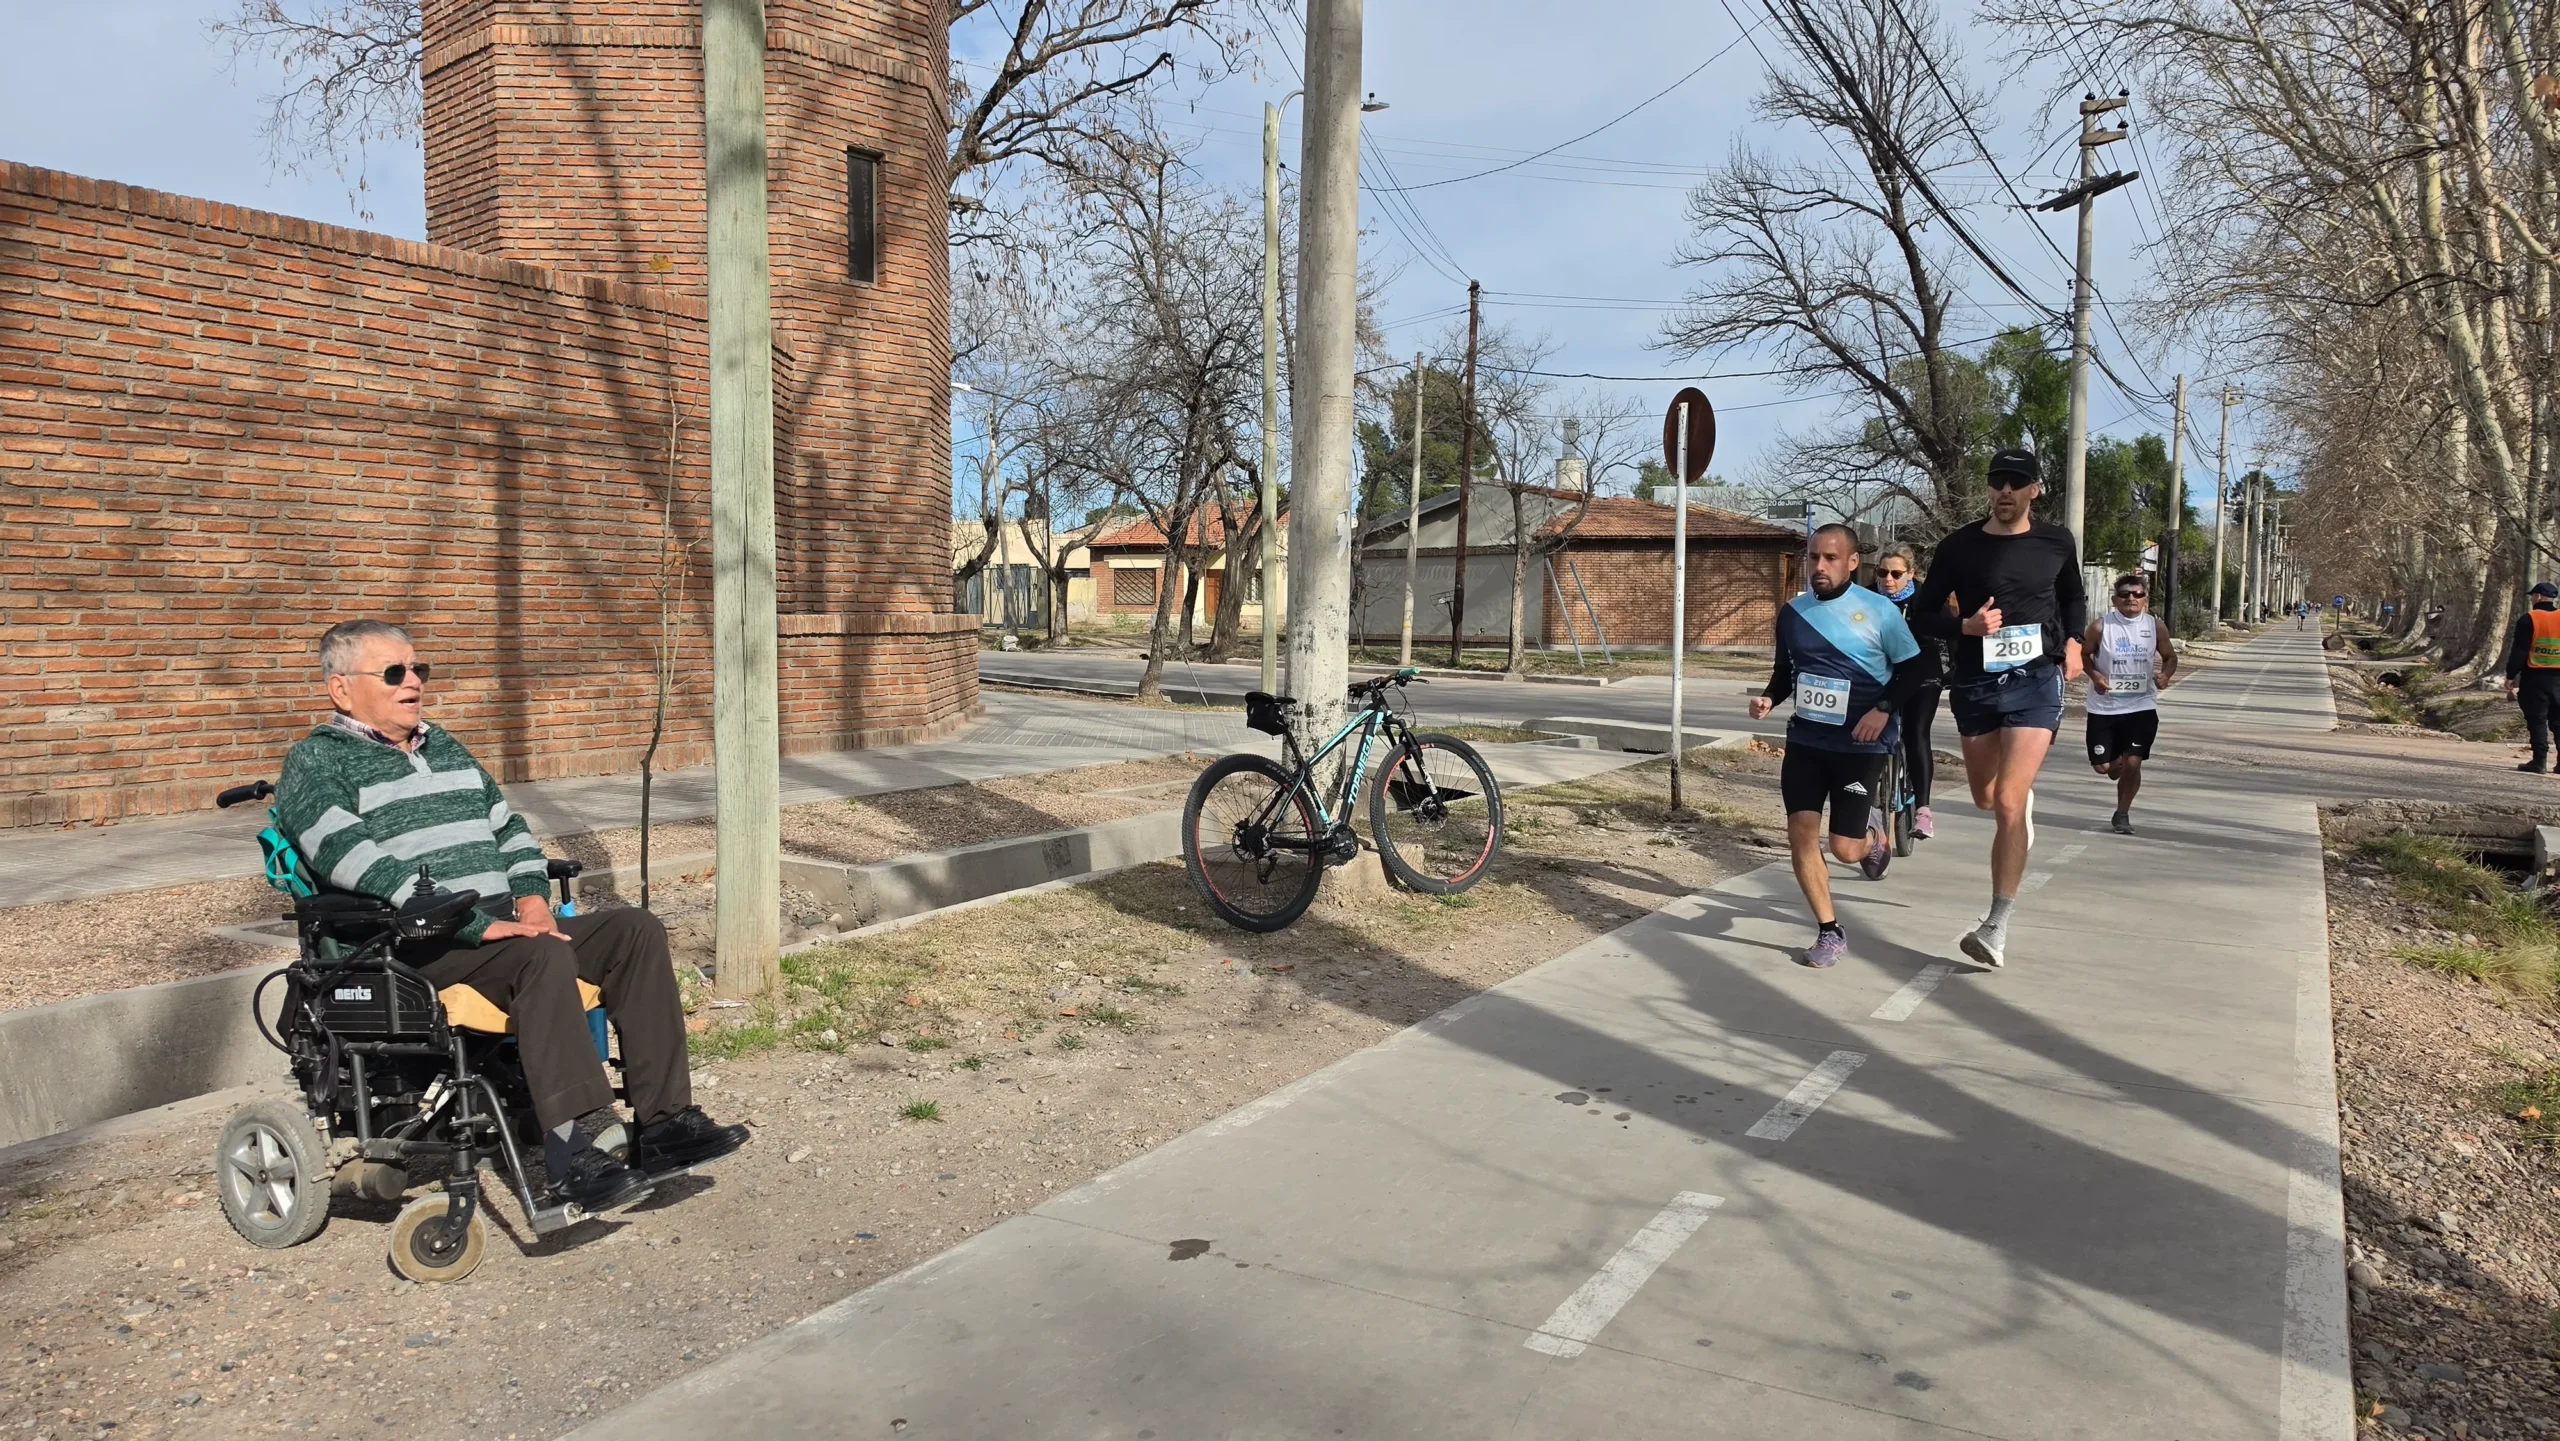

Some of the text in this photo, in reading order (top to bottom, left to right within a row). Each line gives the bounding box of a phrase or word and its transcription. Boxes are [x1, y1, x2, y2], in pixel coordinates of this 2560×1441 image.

[2005, 629, 2021, 637] 21K
[1994, 640, 2033, 658] 280
[1813, 679, 1828, 688] 21K
[2115, 681, 2140, 690] 229
[1803, 689, 1837, 709] 309
[1347, 734, 1375, 805] TOPMEGA
